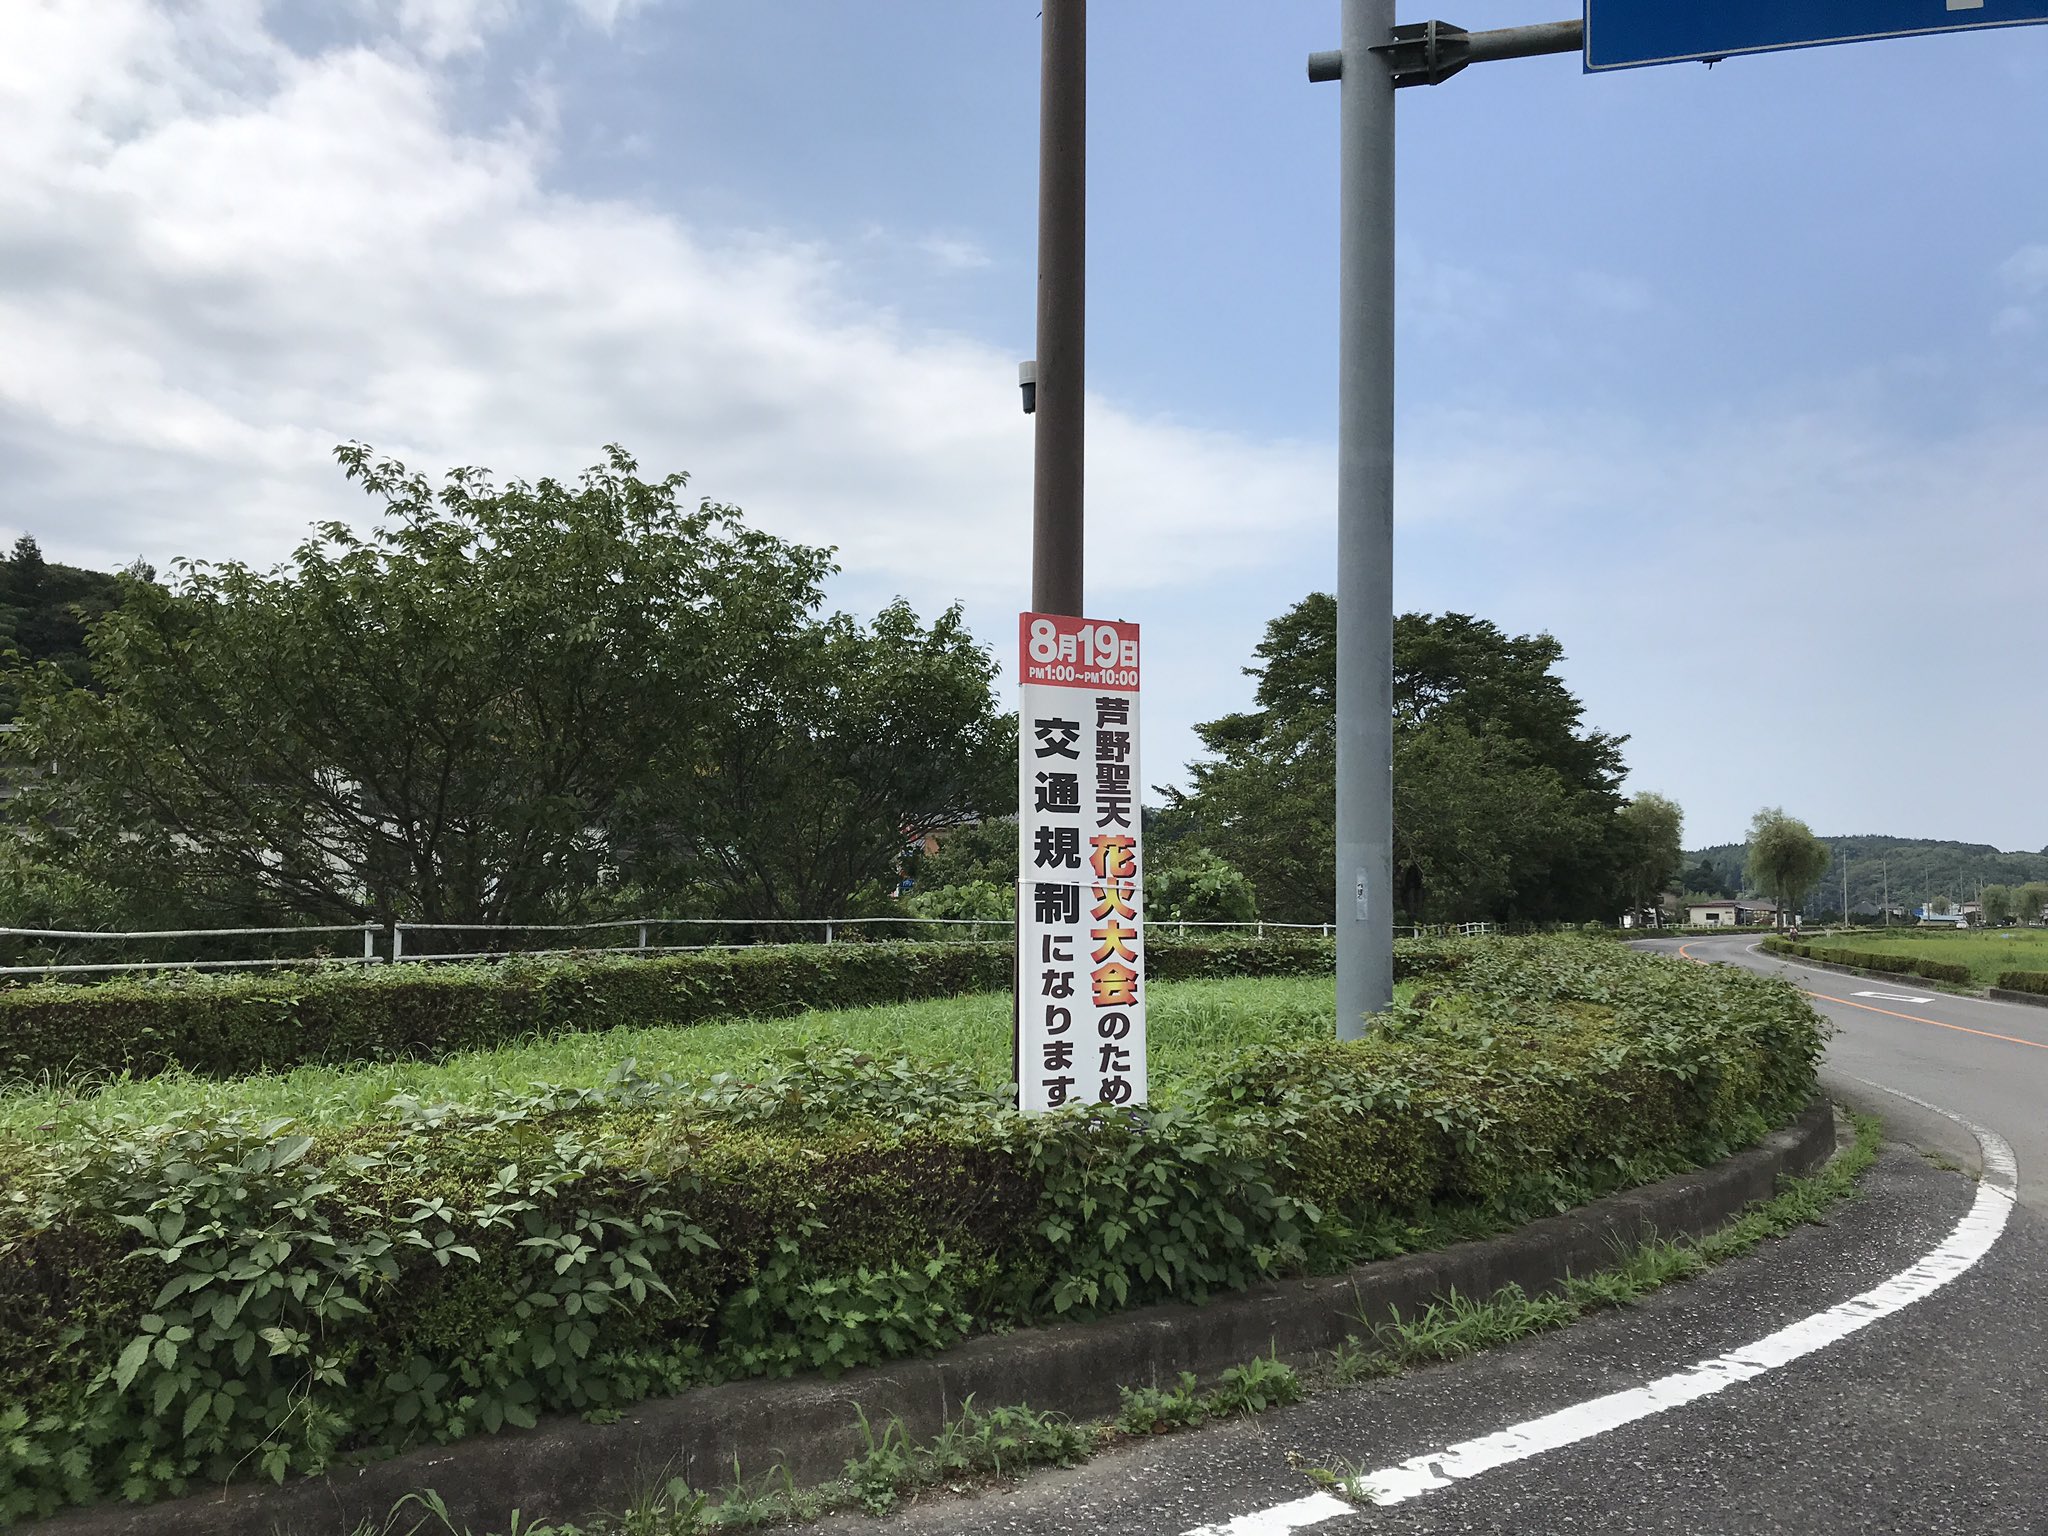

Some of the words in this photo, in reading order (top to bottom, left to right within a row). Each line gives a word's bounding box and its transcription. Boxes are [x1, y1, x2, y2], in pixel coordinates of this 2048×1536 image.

[1028, 618, 1138, 668] 8月19日
[1034, 717, 1081, 1107] 交通規制になります
[1089, 696, 1139, 1106] 芦野聖天花火大会のため
